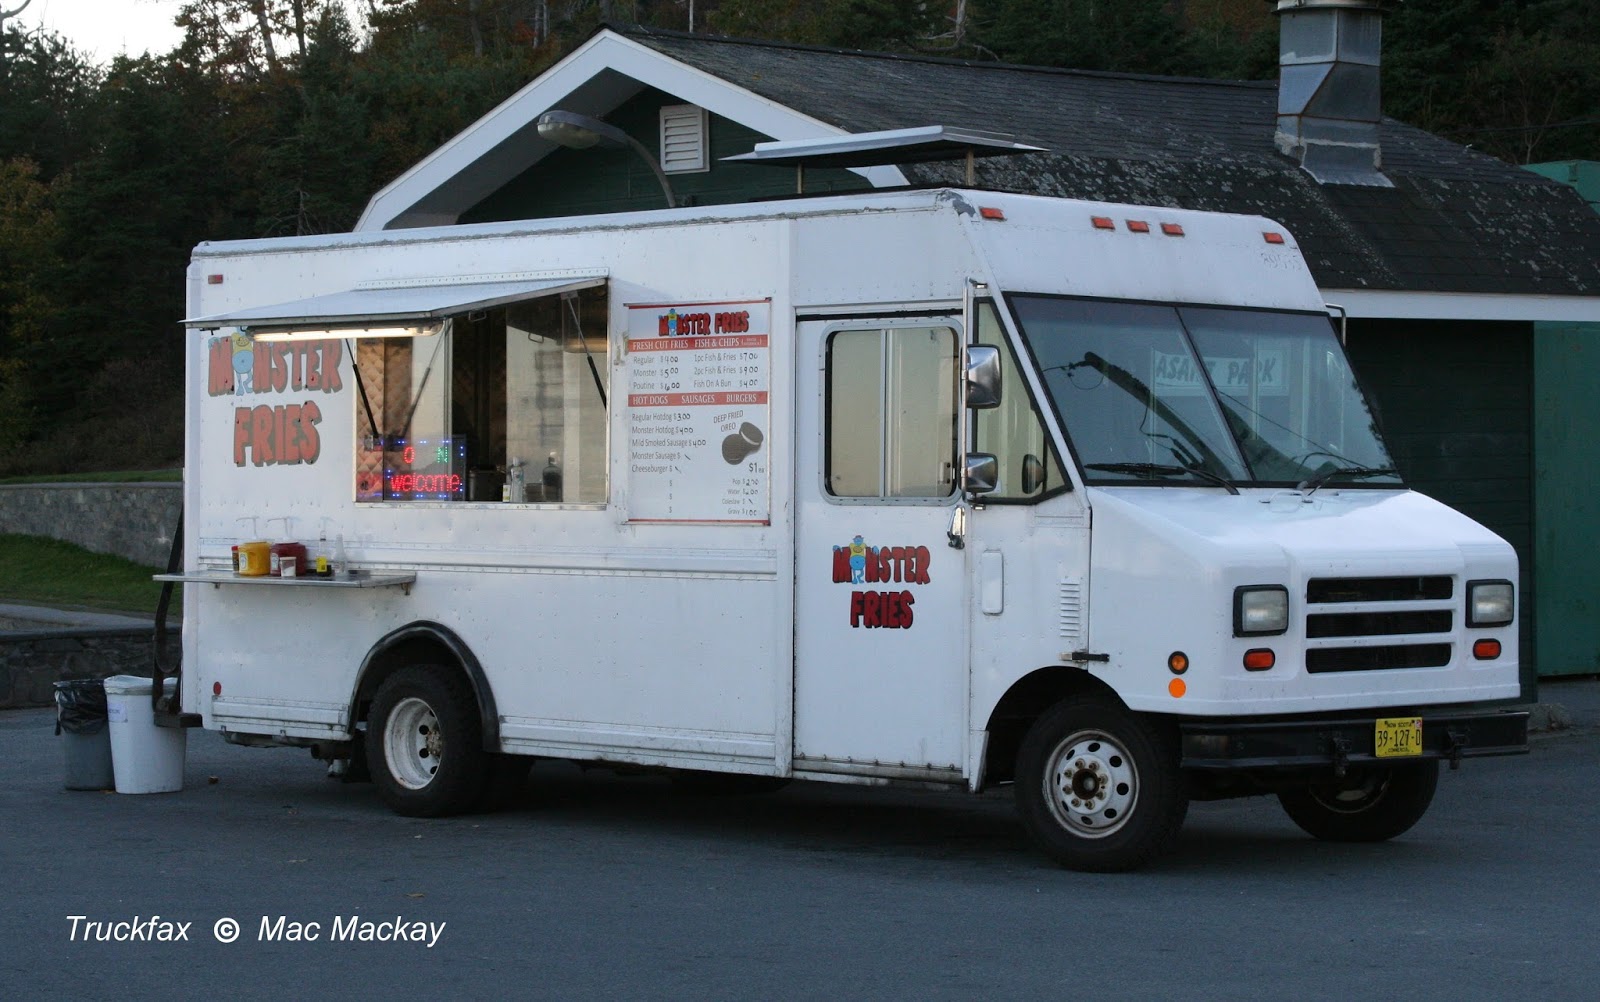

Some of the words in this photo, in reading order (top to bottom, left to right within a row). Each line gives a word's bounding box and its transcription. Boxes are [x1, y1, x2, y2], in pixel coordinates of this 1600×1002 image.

[714, 310, 749, 334] FRIES
[633, 342, 654, 350] FRESH
[655, 341, 668, 349] CUT
[671, 340, 688, 349] FRIES
[695, 339, 710, 348] FISH
[712, 339, 717, 347] &
[719, 338, 739, 347] CHIPS
[634, 356, 654, 365] Regular
[694, 354, 703, 363] 1pc
[705, 354, 716, 362] Fish
[723, 353, 736, 361] Fries
[634, 369, 656, 377] Monster
[694, 367, 703, 376] 2pc
[705, 367, 716, 375] Fish
[717, 366, 722, 374] &
[723, 366, 736, 374] Fries
[634, 382, 654, 390] Poutine
[694, 380, 705, 388] Fish
[721, 379, 731, 387] Bun
[633, 396, 648, 405] HOT
[650, 395, 668, 404] DOGS
[682, 394, 715, 404] SAUSAGES
[726, 394, 756, 402] BURGERS
[632, 413, 652, 421] Regular
[653, 413, 672, 421] Hotdog
[714, 415, 727, 424] DEEP
[728, 410, 744, 420] FRIED
[656, 426, 674, 435] Hotdog
[721, 422, 736, 432] OREO
[234, 400, 322, 467] FRIES
[643, 439, 666, 447] Smoked
[666, 440, 688, 448] Sausage
[655, 452, 676, 461] Sausage
[632, 465, 668, 474] Cheeseburger
[391, 472, 460, 492] welcome
[850, 590, 915, 629] FRIES
